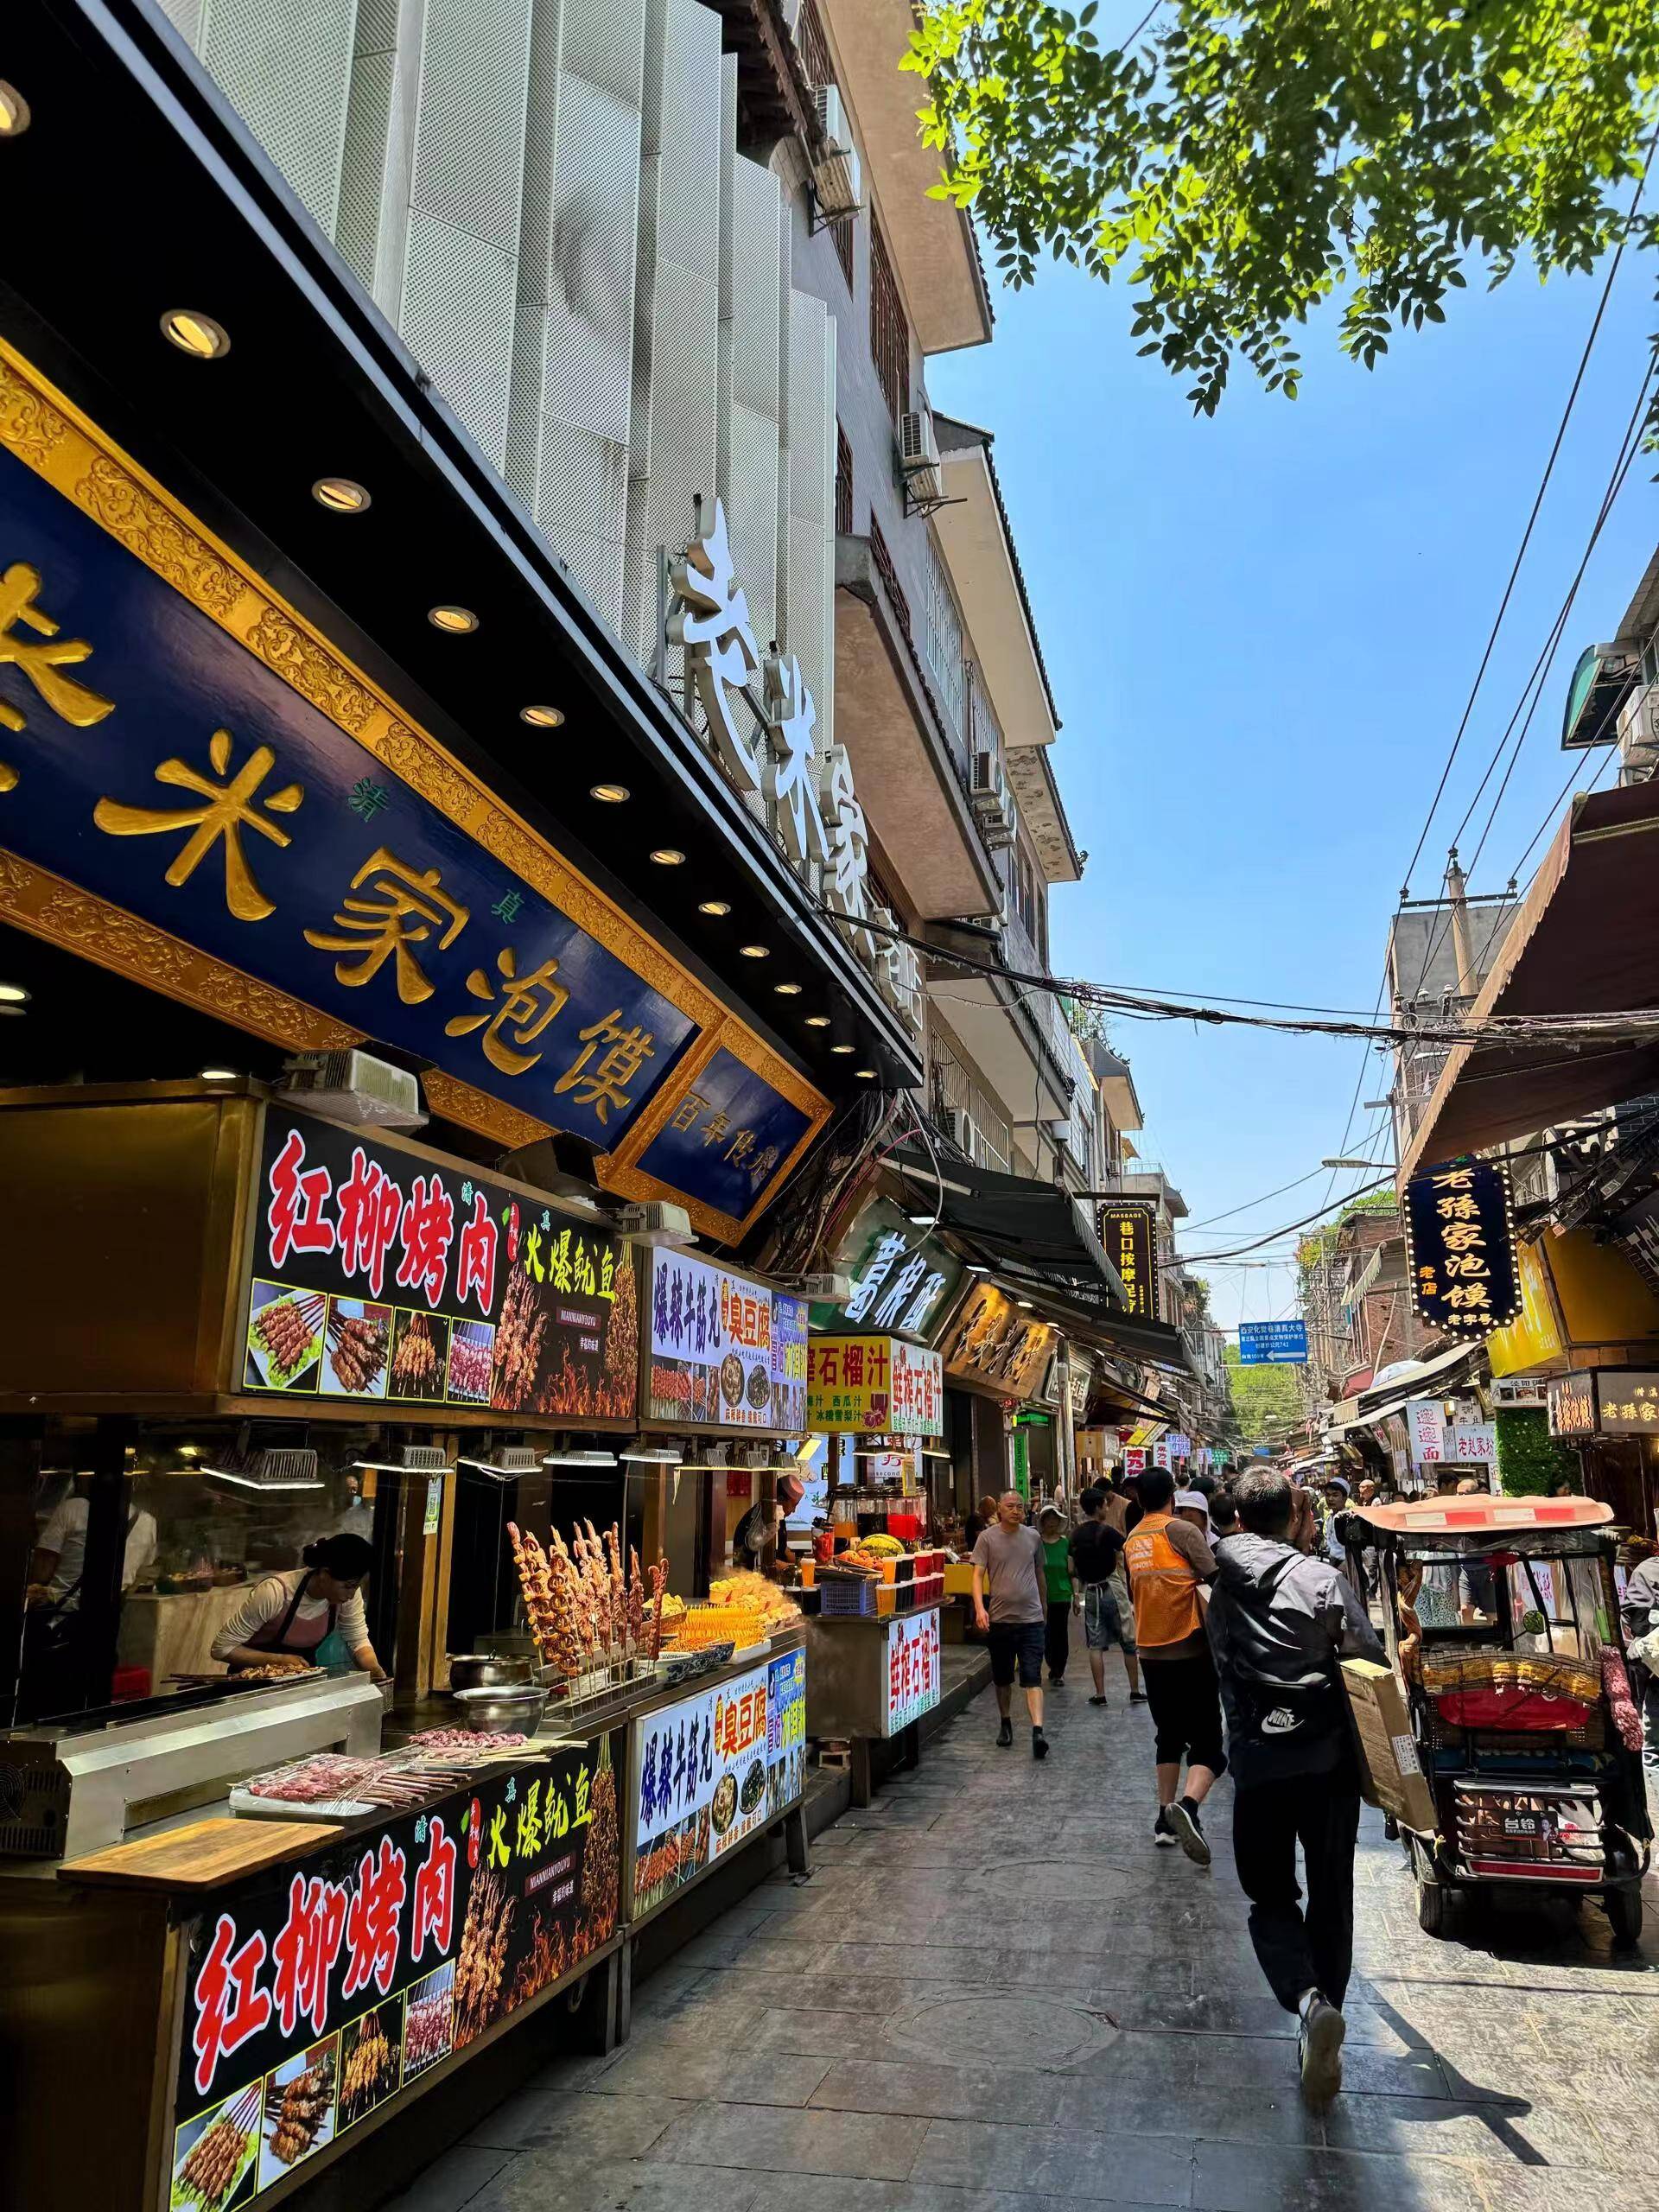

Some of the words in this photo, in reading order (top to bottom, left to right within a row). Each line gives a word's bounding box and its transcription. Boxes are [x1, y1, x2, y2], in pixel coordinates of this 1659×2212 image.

[268, 1128, 499, 1316] 红柳烤肉
[1419, 1265, 1438, 1296] 老店
[728, 1293, 771, 1352] 臭豆腐
[1447, 1313, 1493, 1325] 老字号
[832, 1395, 862, 1408] 西瓜汁
[721, 1686, 766, 1763] 臭豆腐
[1504, 1817, 1535, 1830] 台铃
[194, 1815, 457, 2095] 红柳烤肉
